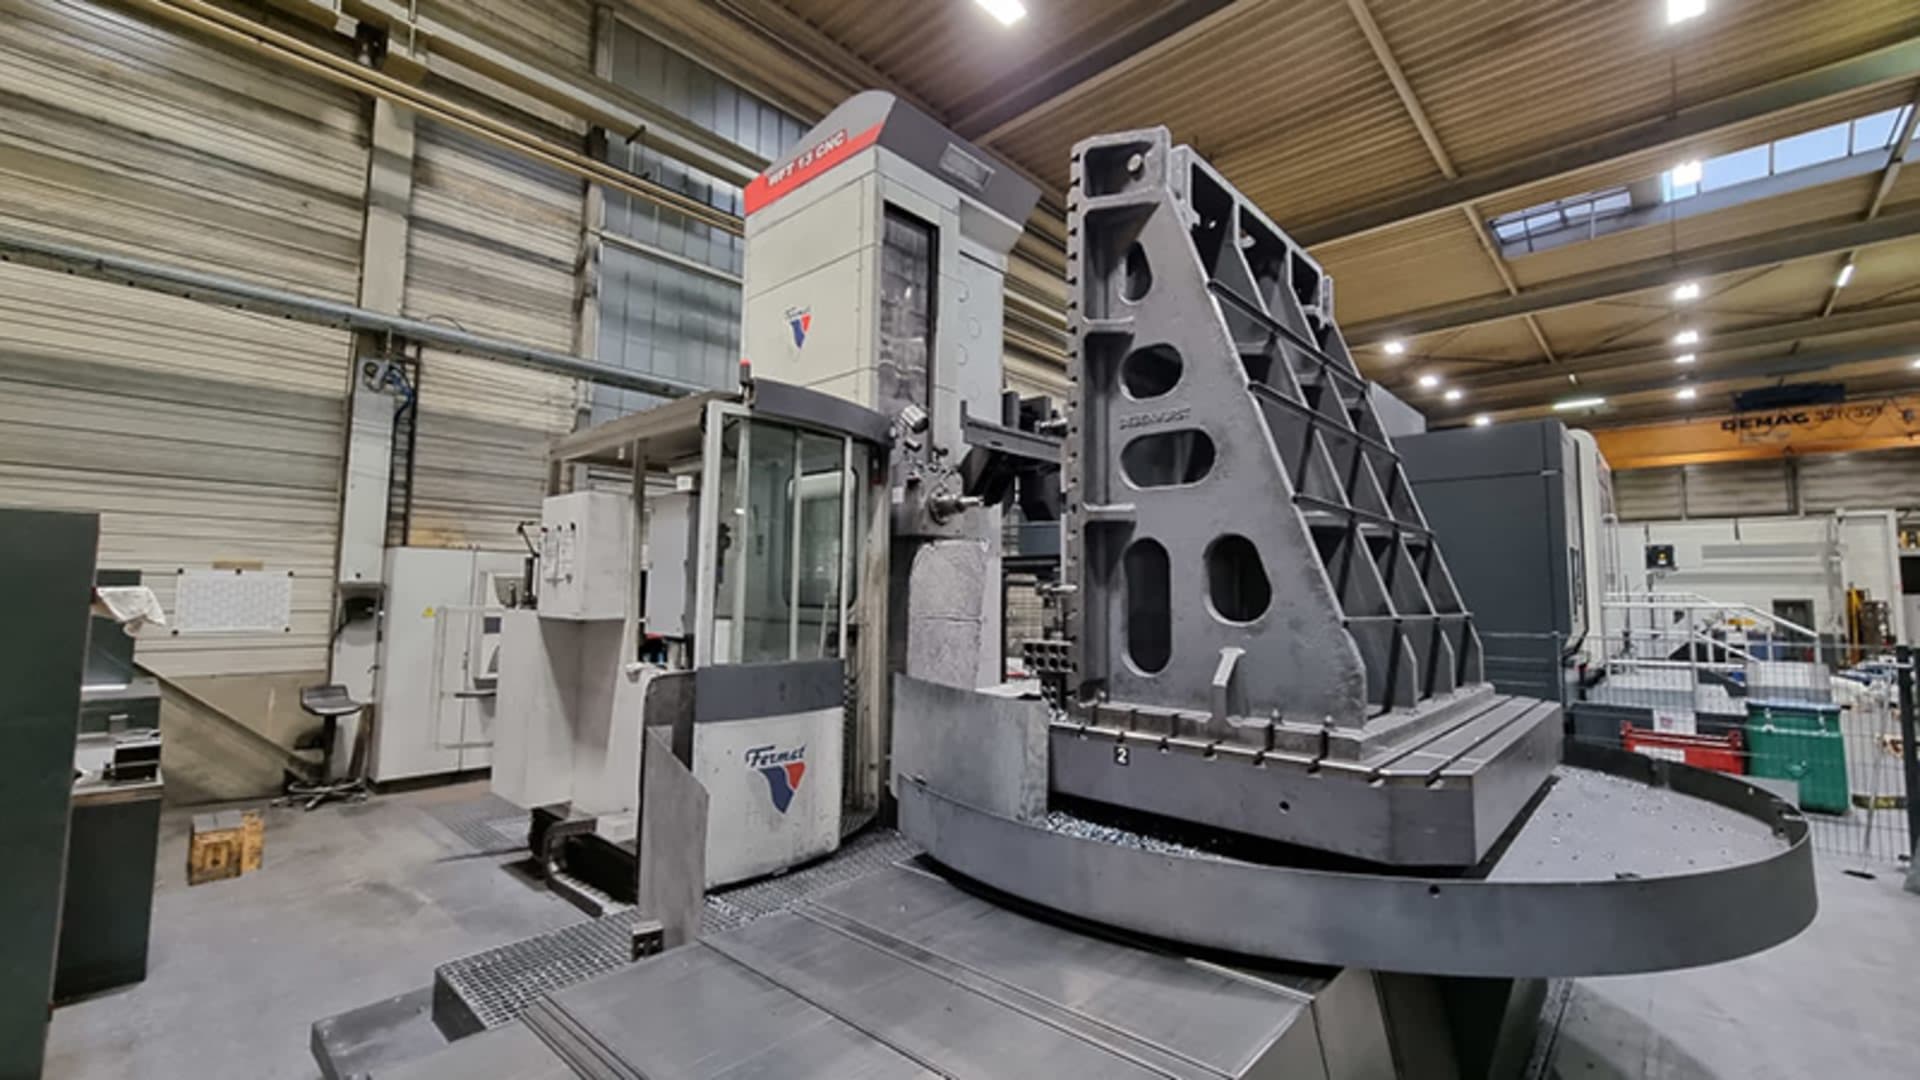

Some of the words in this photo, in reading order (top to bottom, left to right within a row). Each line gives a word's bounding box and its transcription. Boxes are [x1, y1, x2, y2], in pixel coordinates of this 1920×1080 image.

[815, 130, 846, 159] CNC
[1721, 412, 1810, 432] DEMAG
[745, 744, 807, 767] Fermat
[1117, 747, 1127, 764] 2
